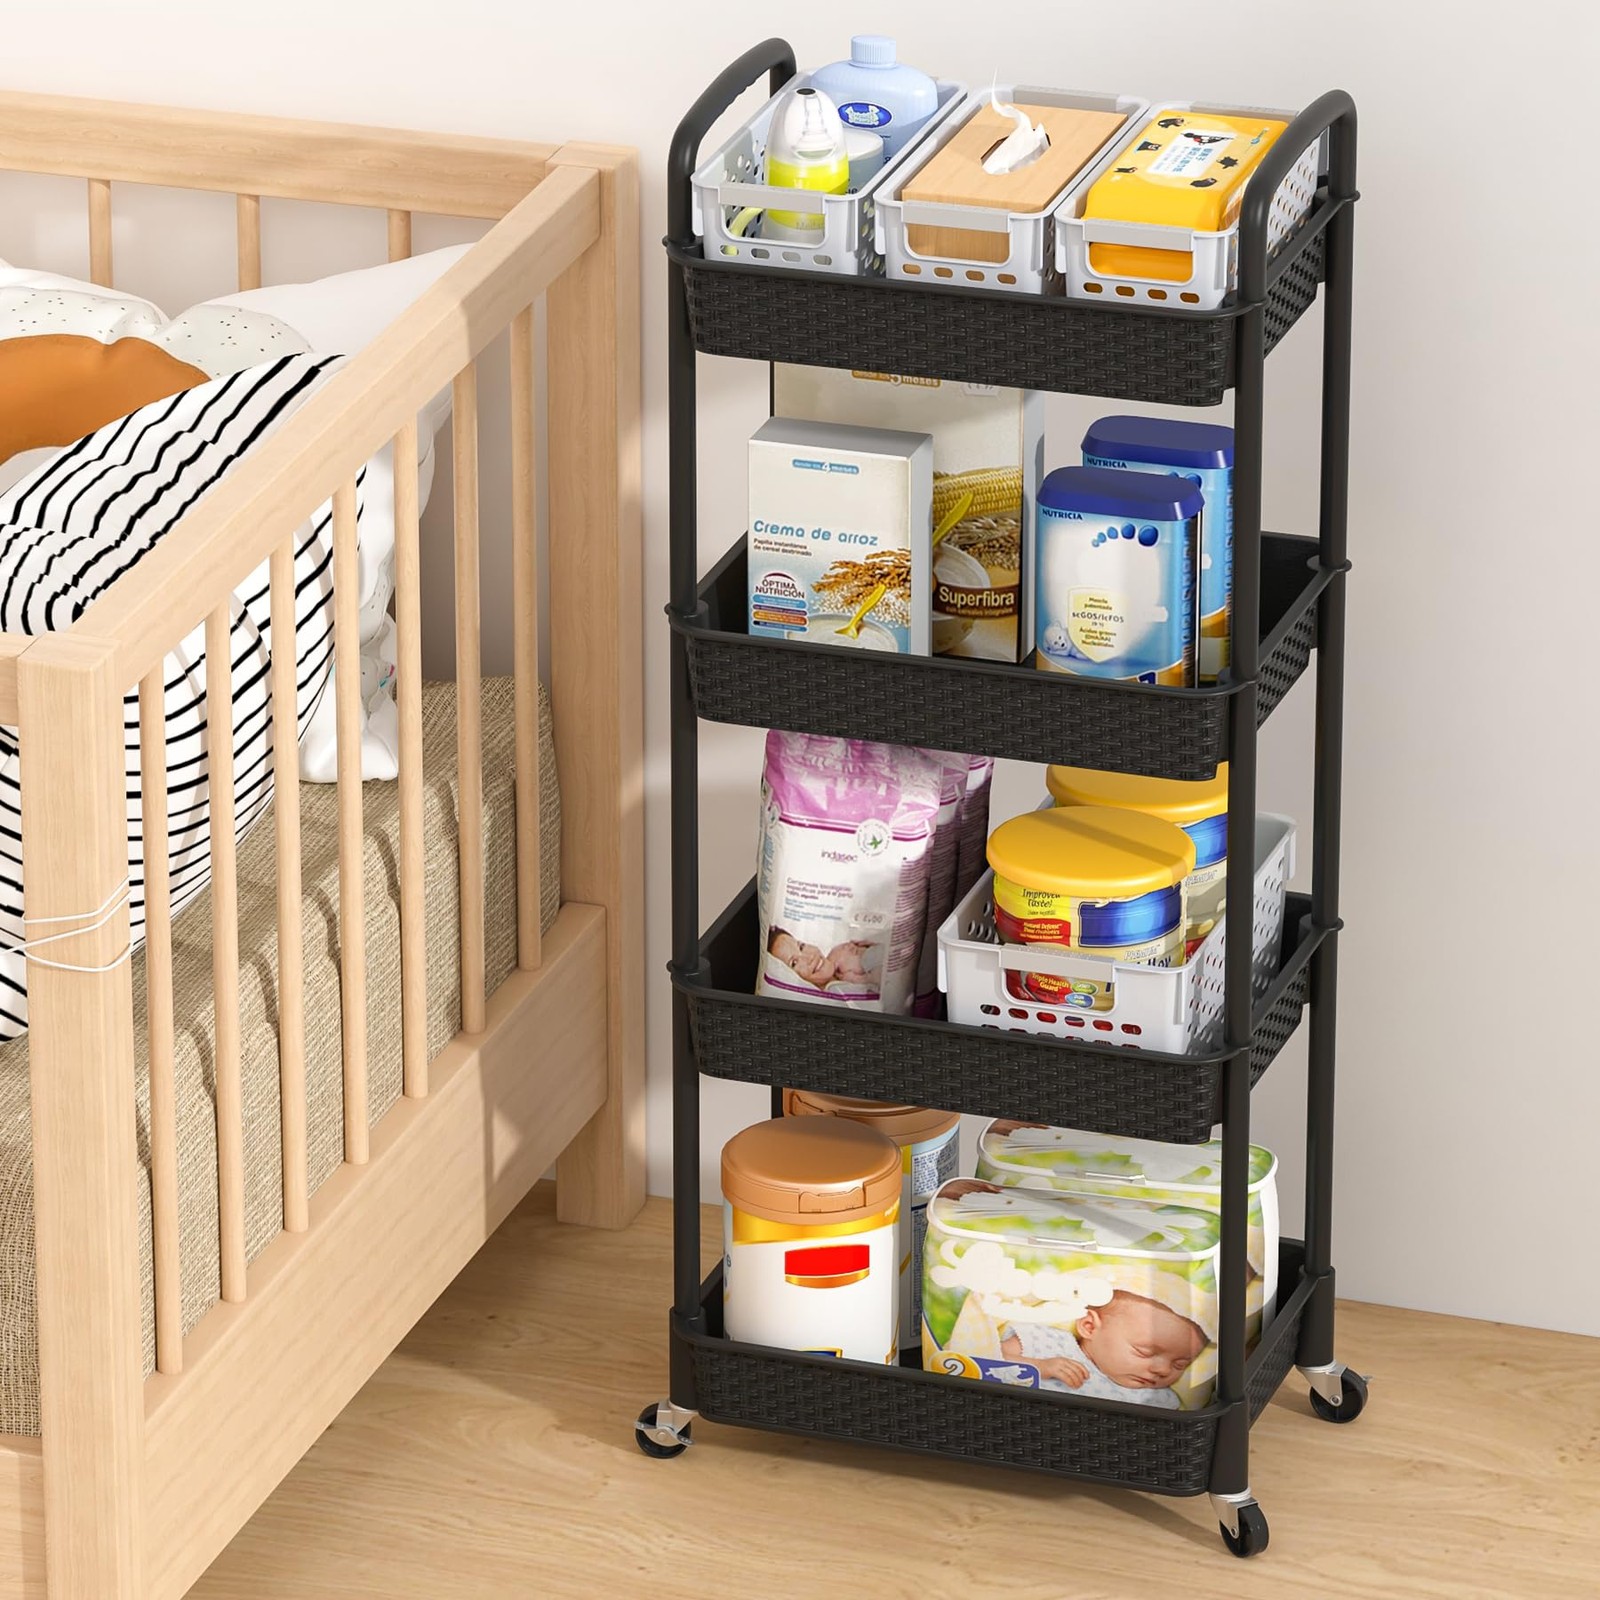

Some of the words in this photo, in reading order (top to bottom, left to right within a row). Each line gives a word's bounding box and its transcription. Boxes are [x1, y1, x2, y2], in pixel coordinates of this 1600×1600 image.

[1087, 457, 1127, 468] NUTRICIA
[1042, 508, 1083, 520] NUTRICIA
[753, 520, 805, 537] Crema
[811, 527, 831, 541] de
[838, 532, 878, 546] arroz
[939, 586, 1014, 608] Superfibra
[943, 1358, 965, 1376] 2
